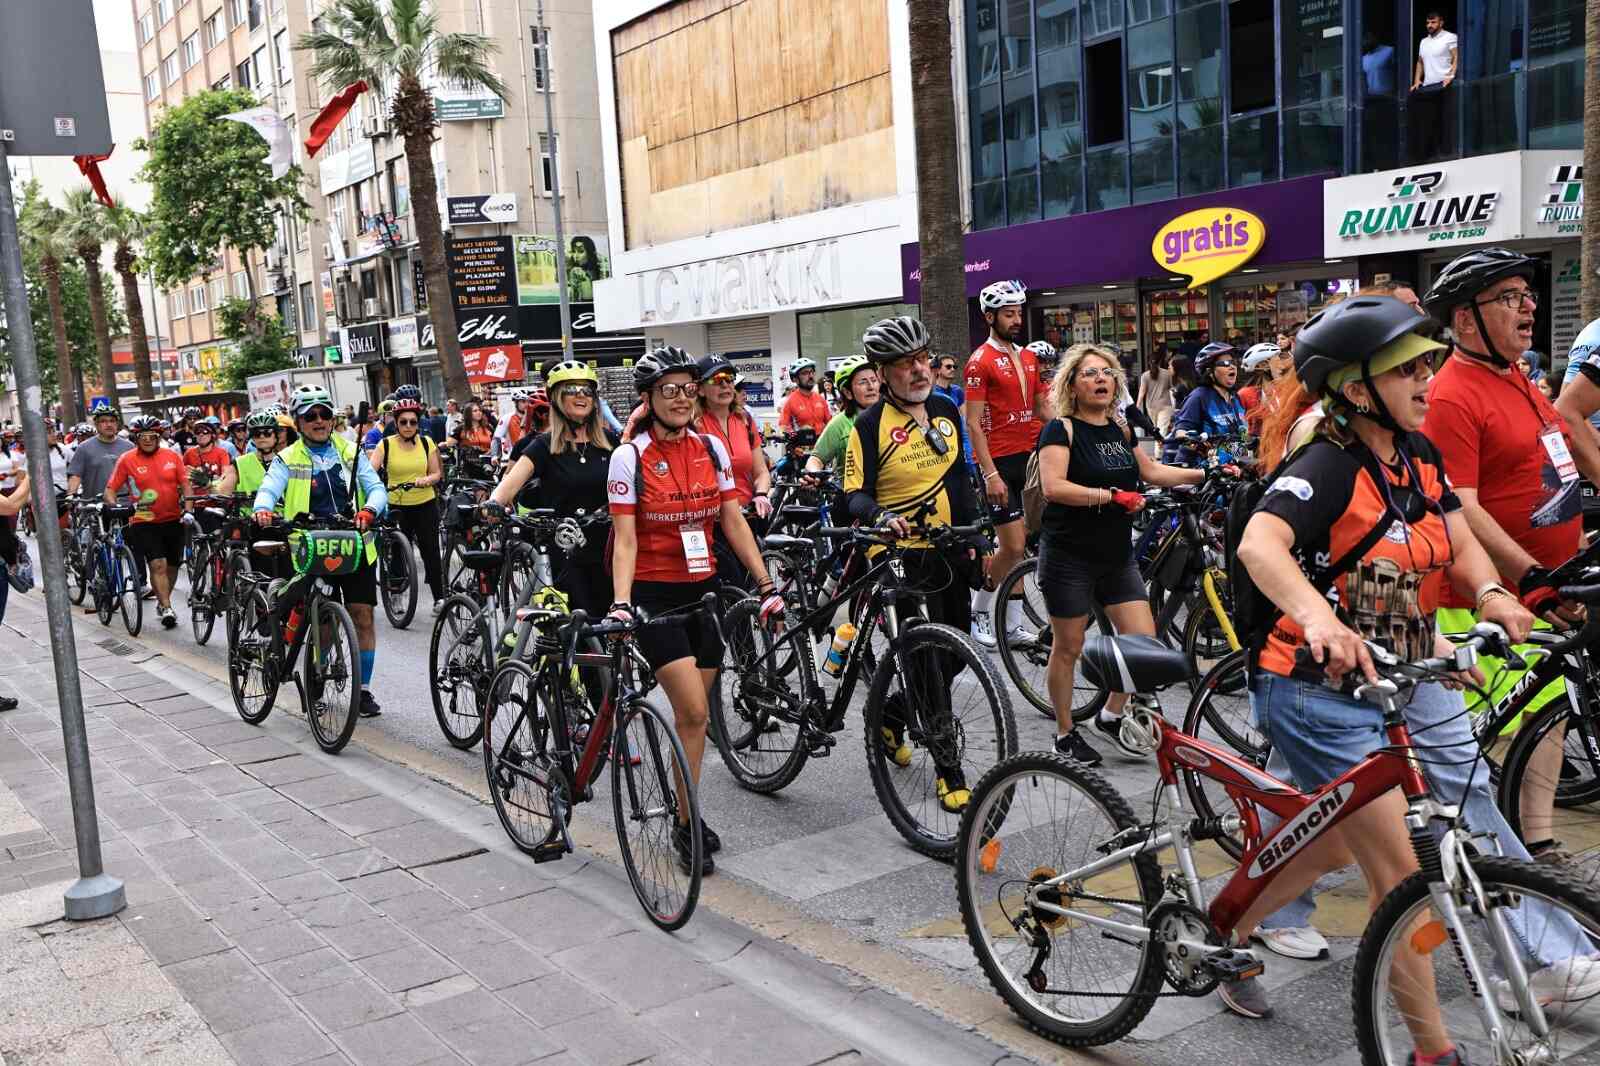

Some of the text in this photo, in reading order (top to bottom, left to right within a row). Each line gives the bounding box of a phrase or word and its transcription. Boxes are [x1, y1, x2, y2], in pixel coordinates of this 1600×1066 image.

[1338, 192, 1497, 236] RUNLINE
[1544, 205, 1584, 222] RUNL
[1163, 213, 1250, 264] gratis
[1428, 231, 1455, 242] SPOR
[316, 537, 355, 556] BFN
[1257, 788, 1345, 873] Bianchi
